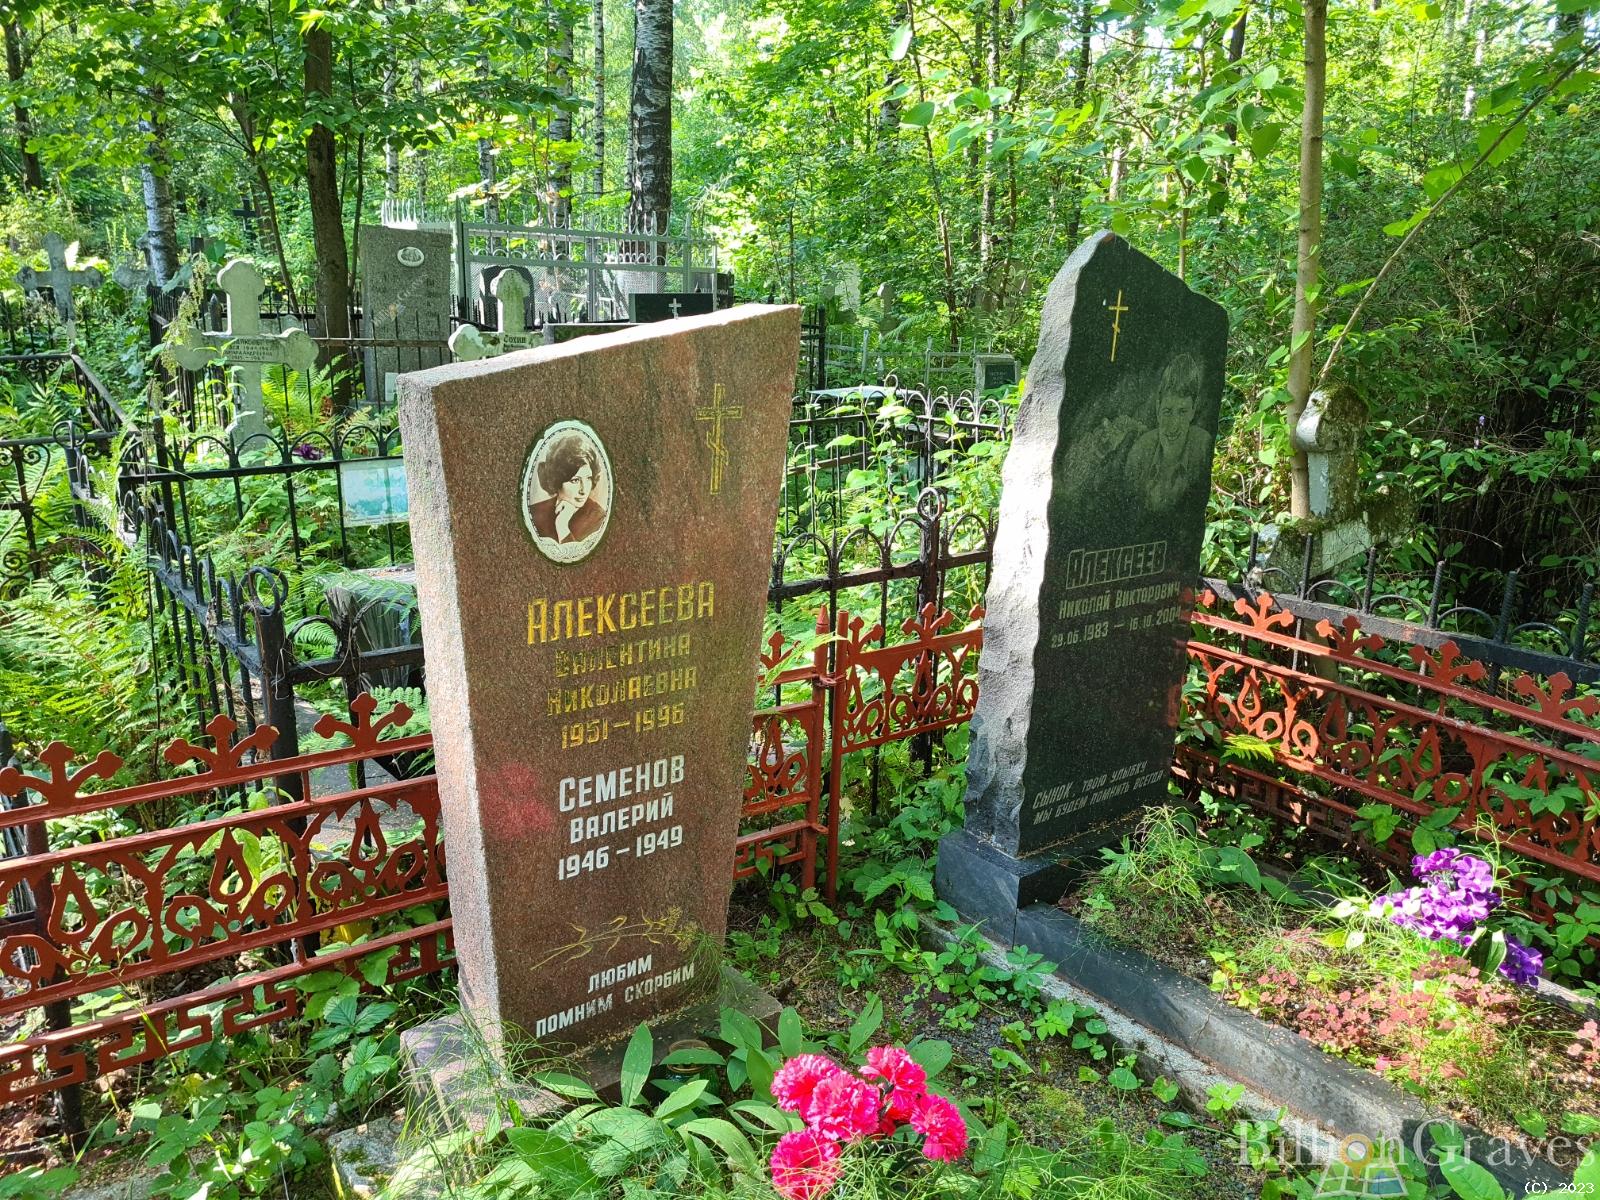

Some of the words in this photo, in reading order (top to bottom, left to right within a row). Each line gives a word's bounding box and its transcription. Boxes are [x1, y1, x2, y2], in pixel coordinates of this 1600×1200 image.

[1066, 540, 1168, 590] АЛЕКСЕЕВ
[527, 580, 715, 645] АЛЕКСЕЕВА
[1058, 590, 1111, 620] НИКОЛАЙ
[1115, 581, 1181, 609] ВИКТОРОВИЧ
[555, 632, 691, 678] ВАЛЕНТИНА
[547, 666, 697, 717] НИКОЛАЕВНА
[559, 754, 685, 813] СЕМЕНОВ
[1033, 808, 1053, 825] МЫ
[1055, 795, 1089, 818] БУДЕМ
[1090, 781, 1130, 806] ПОМНИТЬ
[1082, 774, 1108, 793] ТВОЮ
[570, 792, 673, 844] ВАЛЕРИЙ
[588, 954, 652, 994] ЛЮБИМ
[536, 993, 614, 1039] ПОМНИМ
[624, 962, 695, 1004] СКОРБИМ
